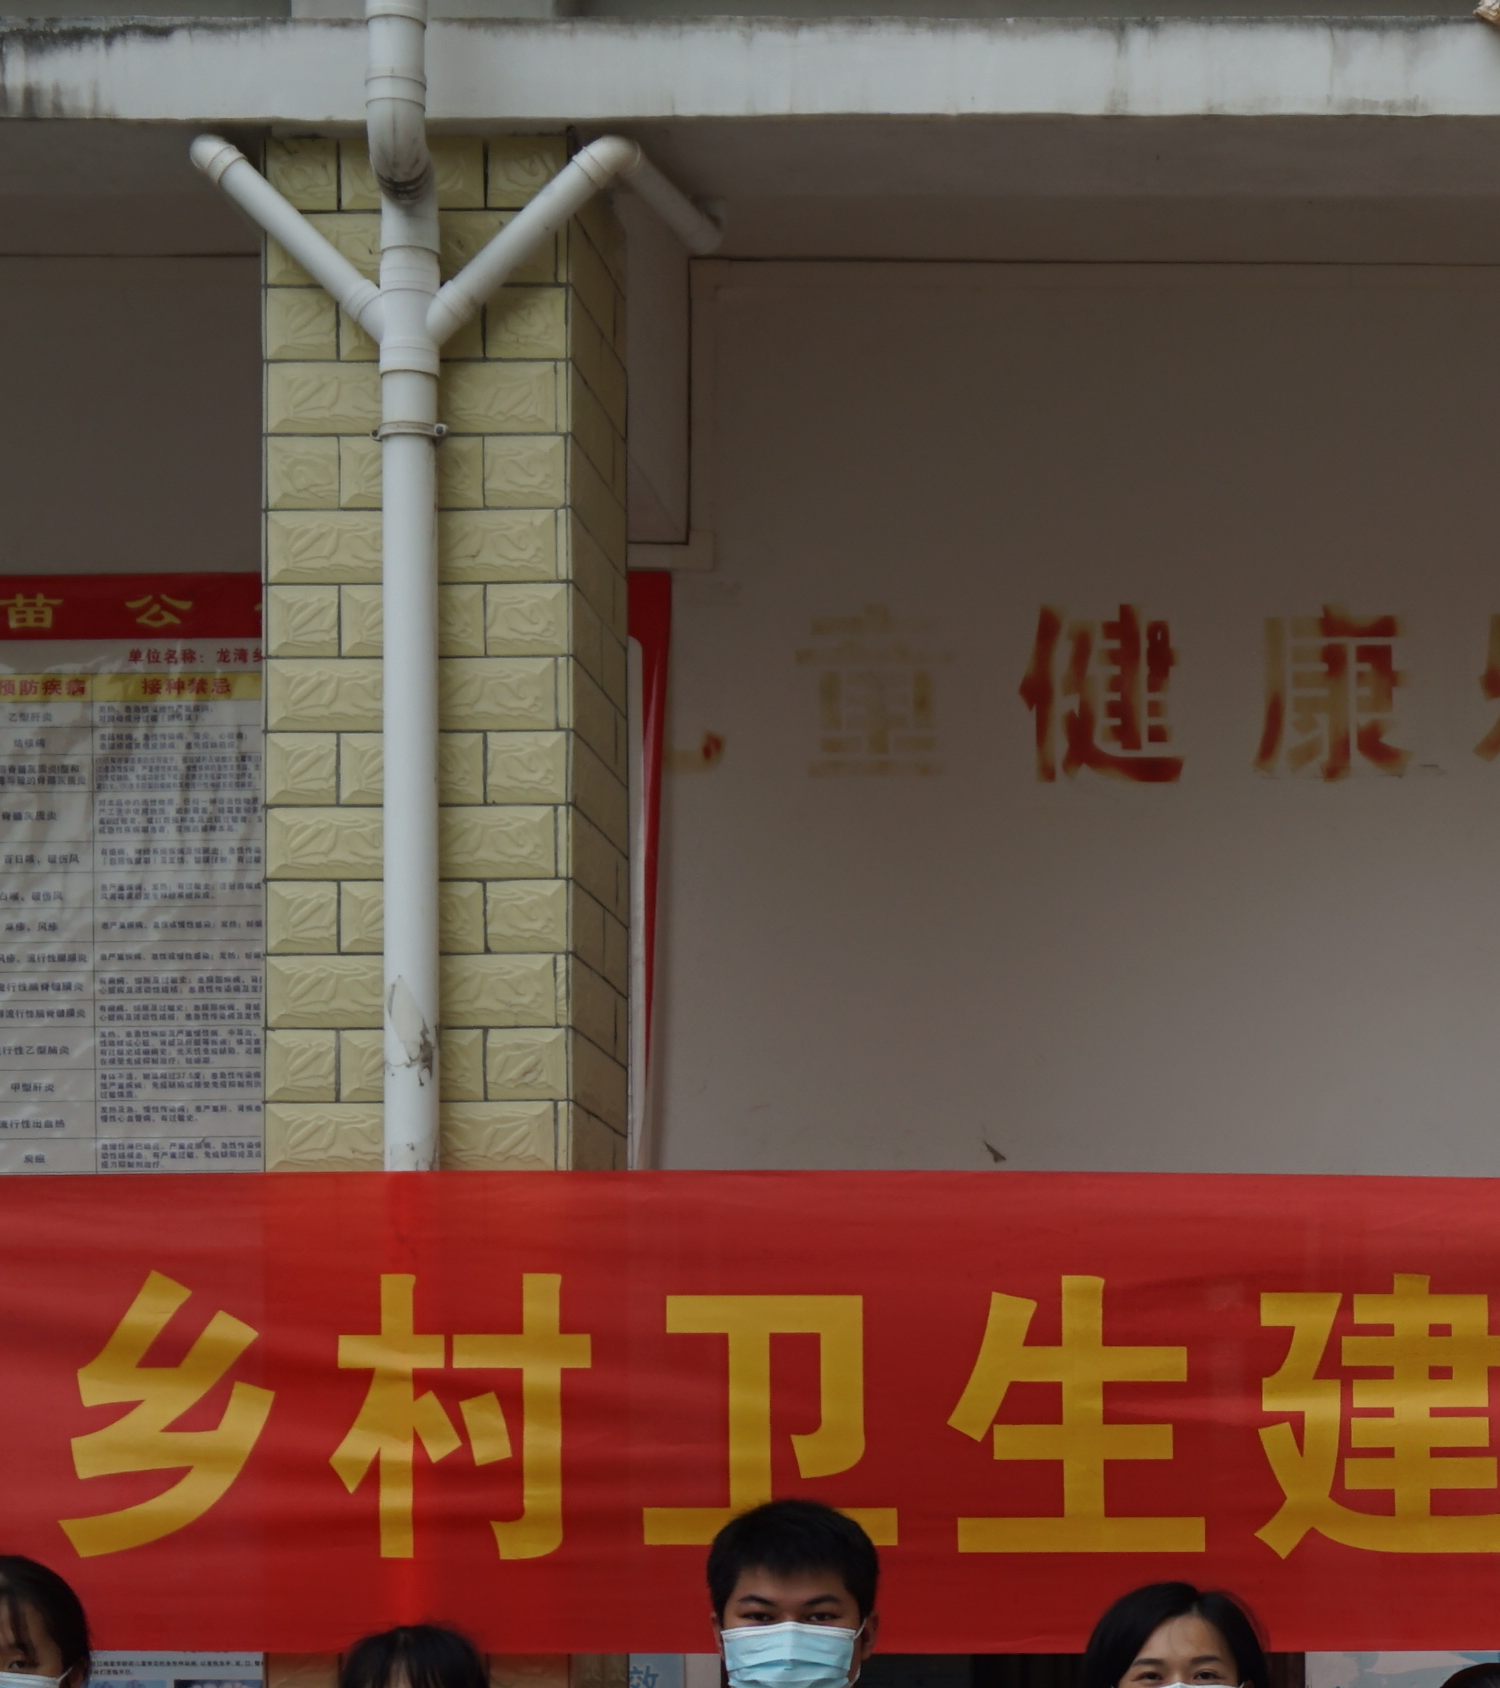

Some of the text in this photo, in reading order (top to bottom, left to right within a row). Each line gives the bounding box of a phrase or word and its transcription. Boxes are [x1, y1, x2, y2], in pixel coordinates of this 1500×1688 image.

[142, 678, 232, 695] 接种禁忌
[11, 1082, 55, 1093] 甲型肝炎
